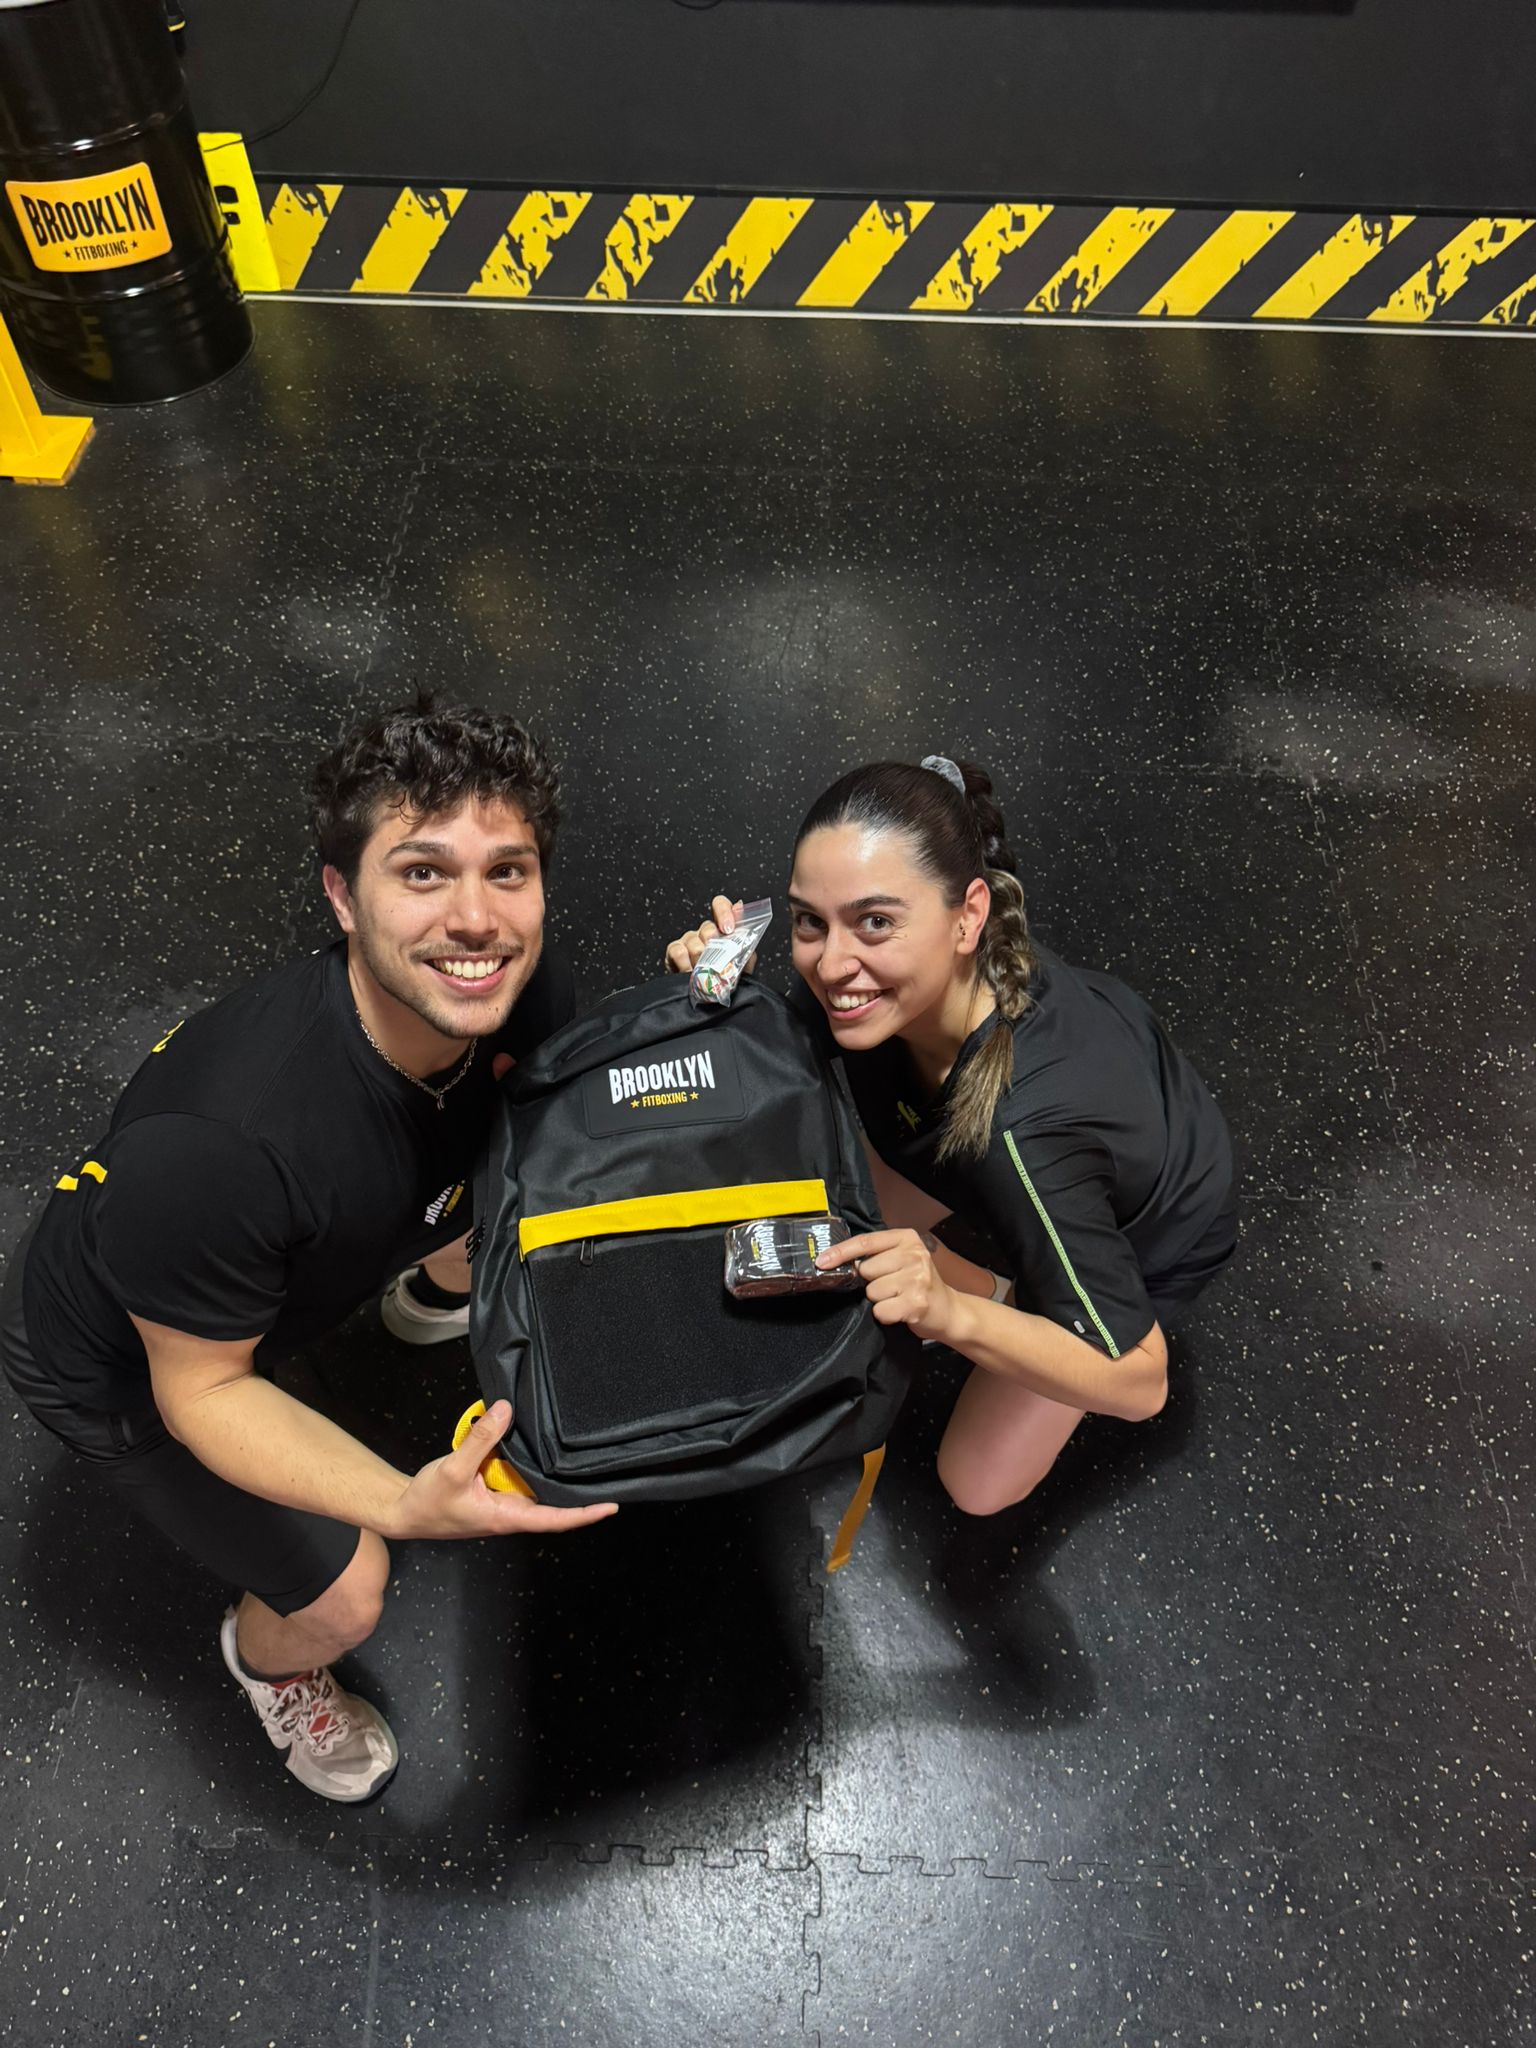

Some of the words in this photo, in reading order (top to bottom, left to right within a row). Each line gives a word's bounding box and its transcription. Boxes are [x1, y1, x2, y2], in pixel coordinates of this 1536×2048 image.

[20, 178, 156, 247] BROOKLYN
[74, 240, 129, 261] FITBOXING
[608, 1050, 716, 1105] BROOKLYN
[642, 1091, 688, 1107] FITBOXING
